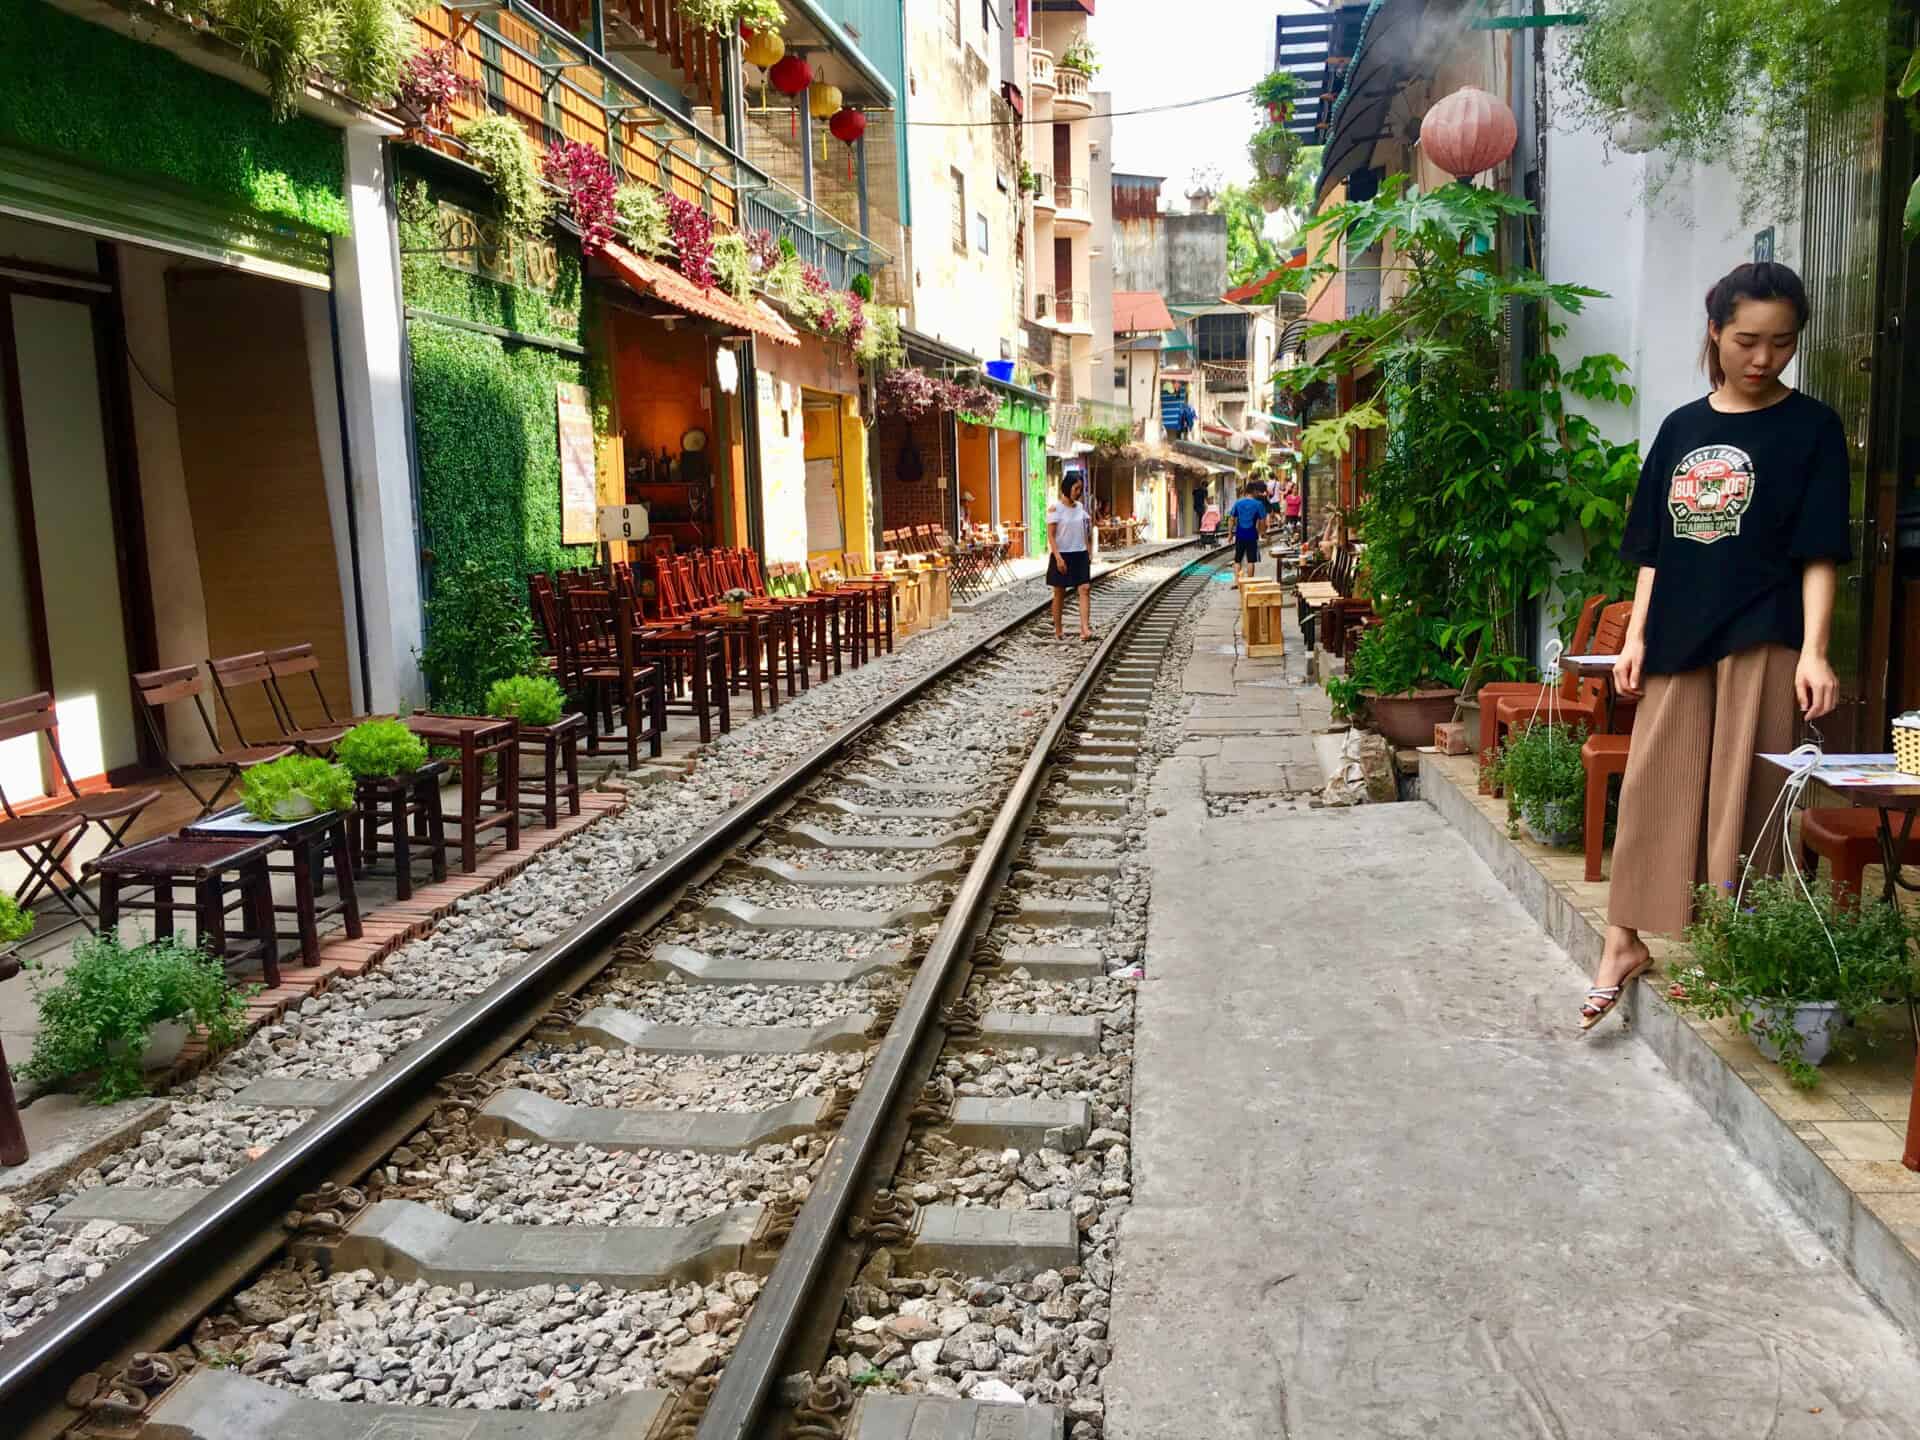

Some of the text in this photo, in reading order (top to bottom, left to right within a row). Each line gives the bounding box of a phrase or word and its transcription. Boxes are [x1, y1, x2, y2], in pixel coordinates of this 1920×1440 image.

[1679, 451, 1708, 473] WEST
[1675, 501, 1741, 517] 19 78
